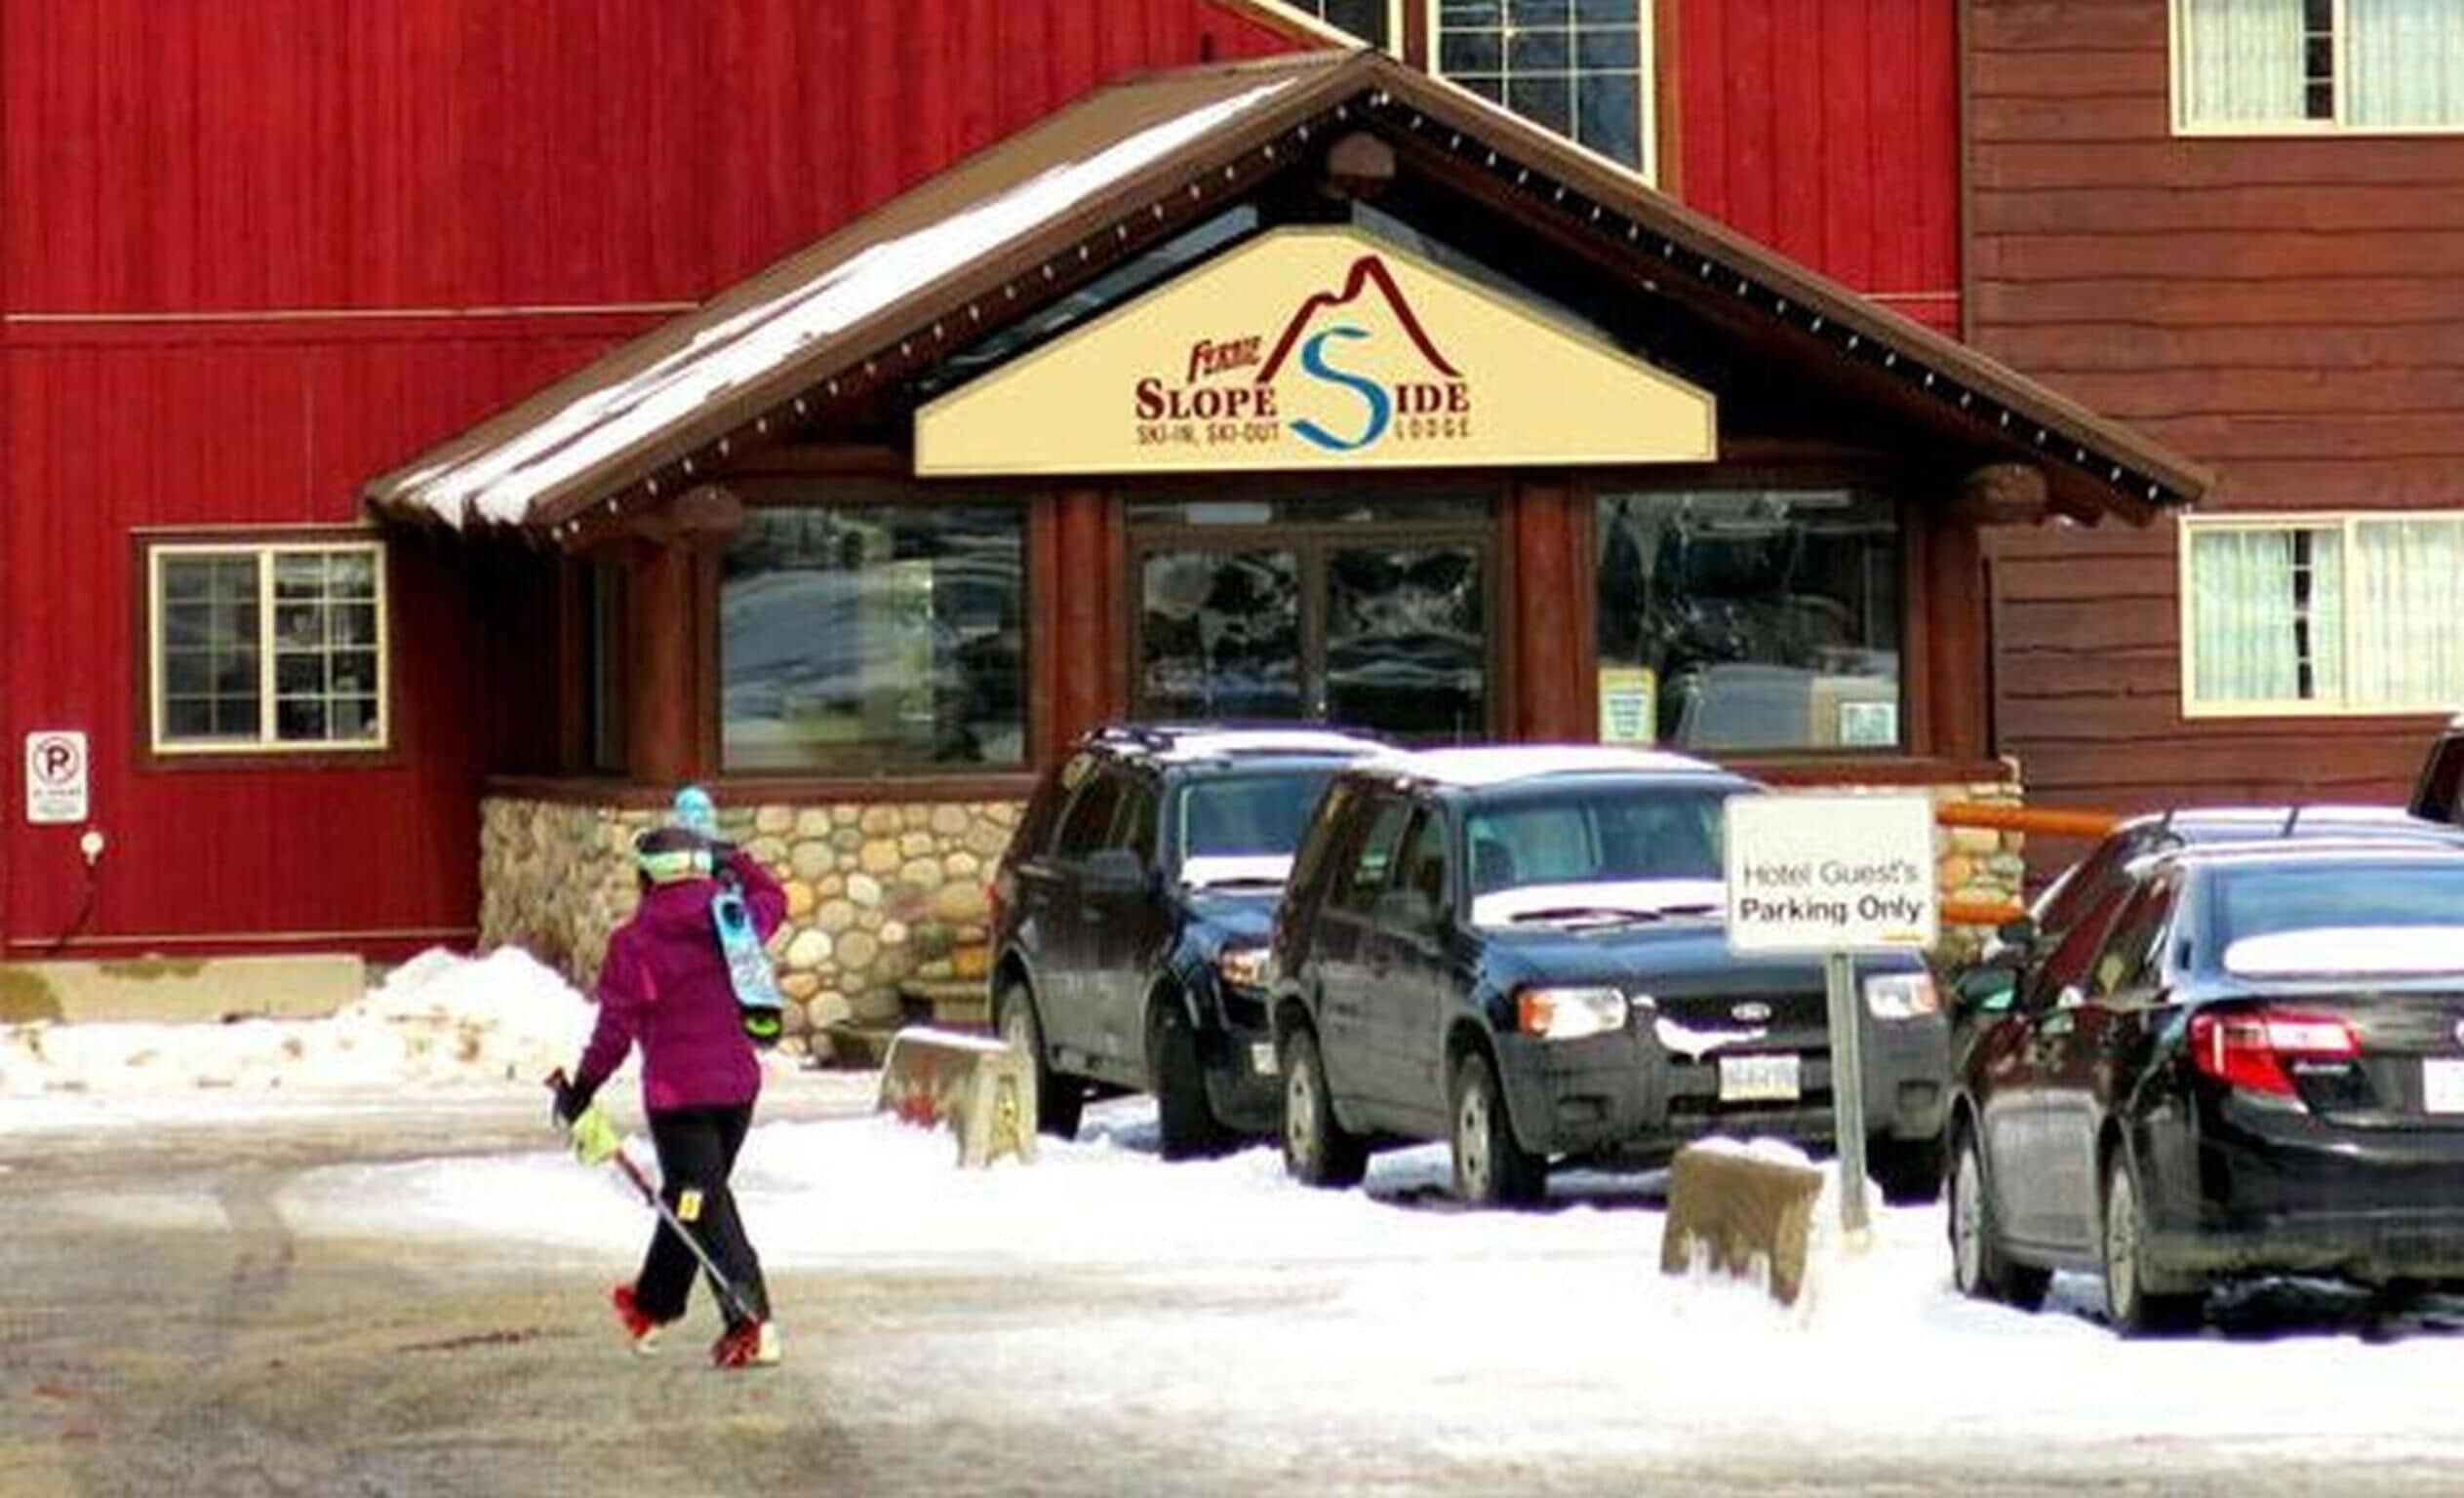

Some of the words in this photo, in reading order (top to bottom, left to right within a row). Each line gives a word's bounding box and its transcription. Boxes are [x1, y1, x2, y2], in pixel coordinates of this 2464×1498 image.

[1135, 377, 1278, 420] SLOPE
[1395, 418, 1470, 440] LODGE
[1743, 859, 1810, 887] Hotel
[1820, 859, 1920, 887] Guest's
[1740, 895, 1848, 925] Parking
[1857, 894, 1924, 925] Only
